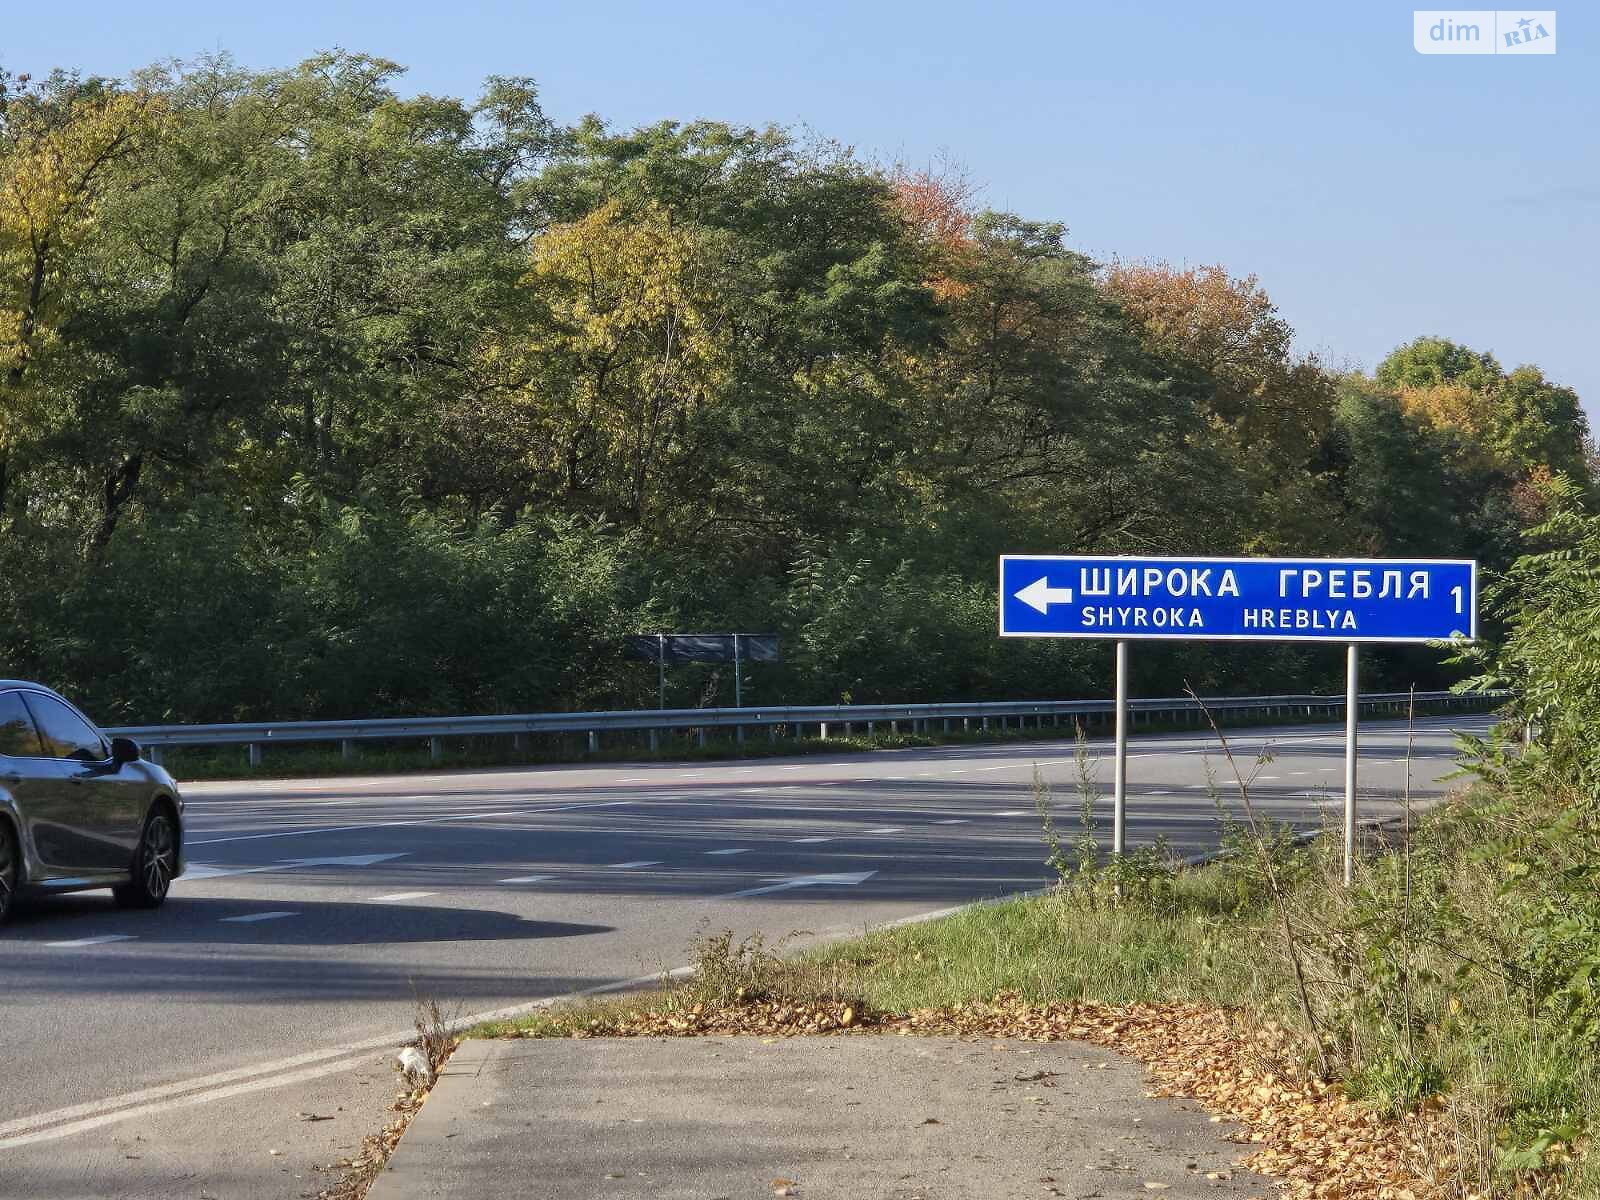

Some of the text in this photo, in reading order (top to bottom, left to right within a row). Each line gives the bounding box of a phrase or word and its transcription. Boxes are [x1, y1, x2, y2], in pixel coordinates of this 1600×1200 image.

[1080, 567, 1430, 599] ШИРОКА ГРЕБЛЯ
[1450, 586, 1462, 614] 1
[1081, 606, 1358, 630] SHYROKA HREBLYA
